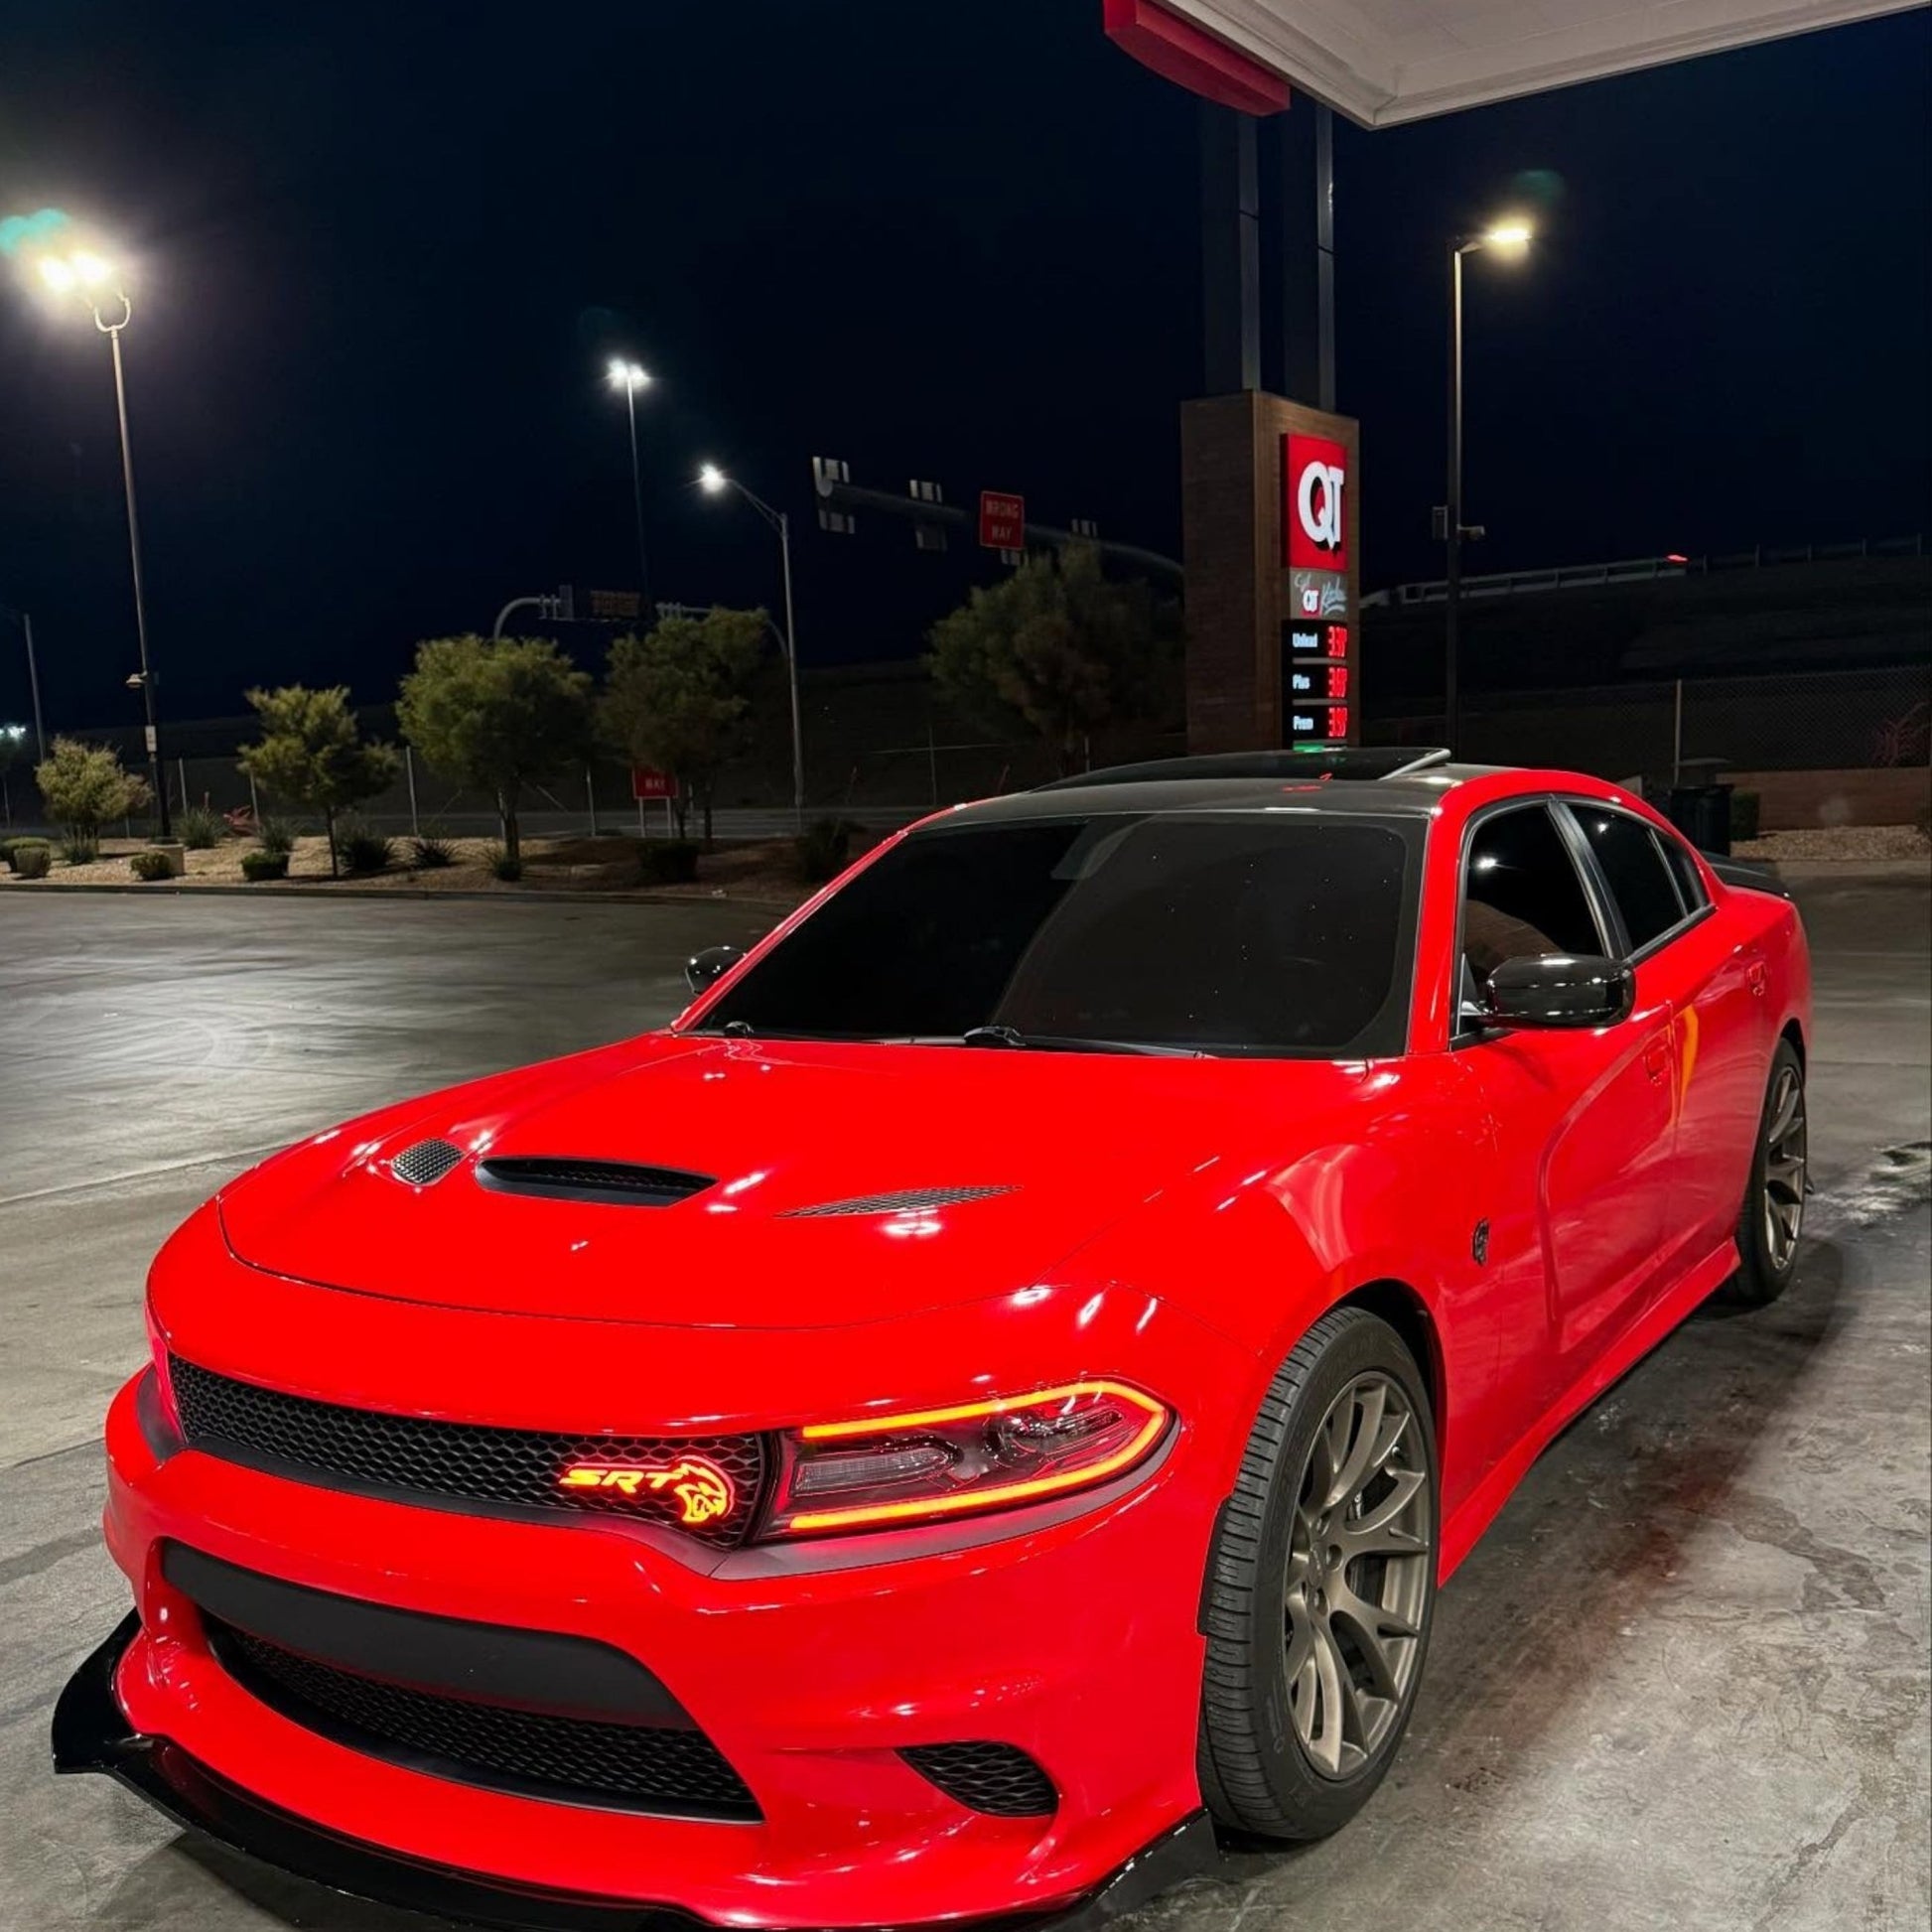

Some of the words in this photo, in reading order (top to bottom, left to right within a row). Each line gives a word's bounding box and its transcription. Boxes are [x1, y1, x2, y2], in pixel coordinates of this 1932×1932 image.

[985, 499, 1020, 519] WRONG
[1297, 461, 1344, 550] QT
[991, 524, 1013, 541] WAY
[559, 1468, 684, 1493] SRT
